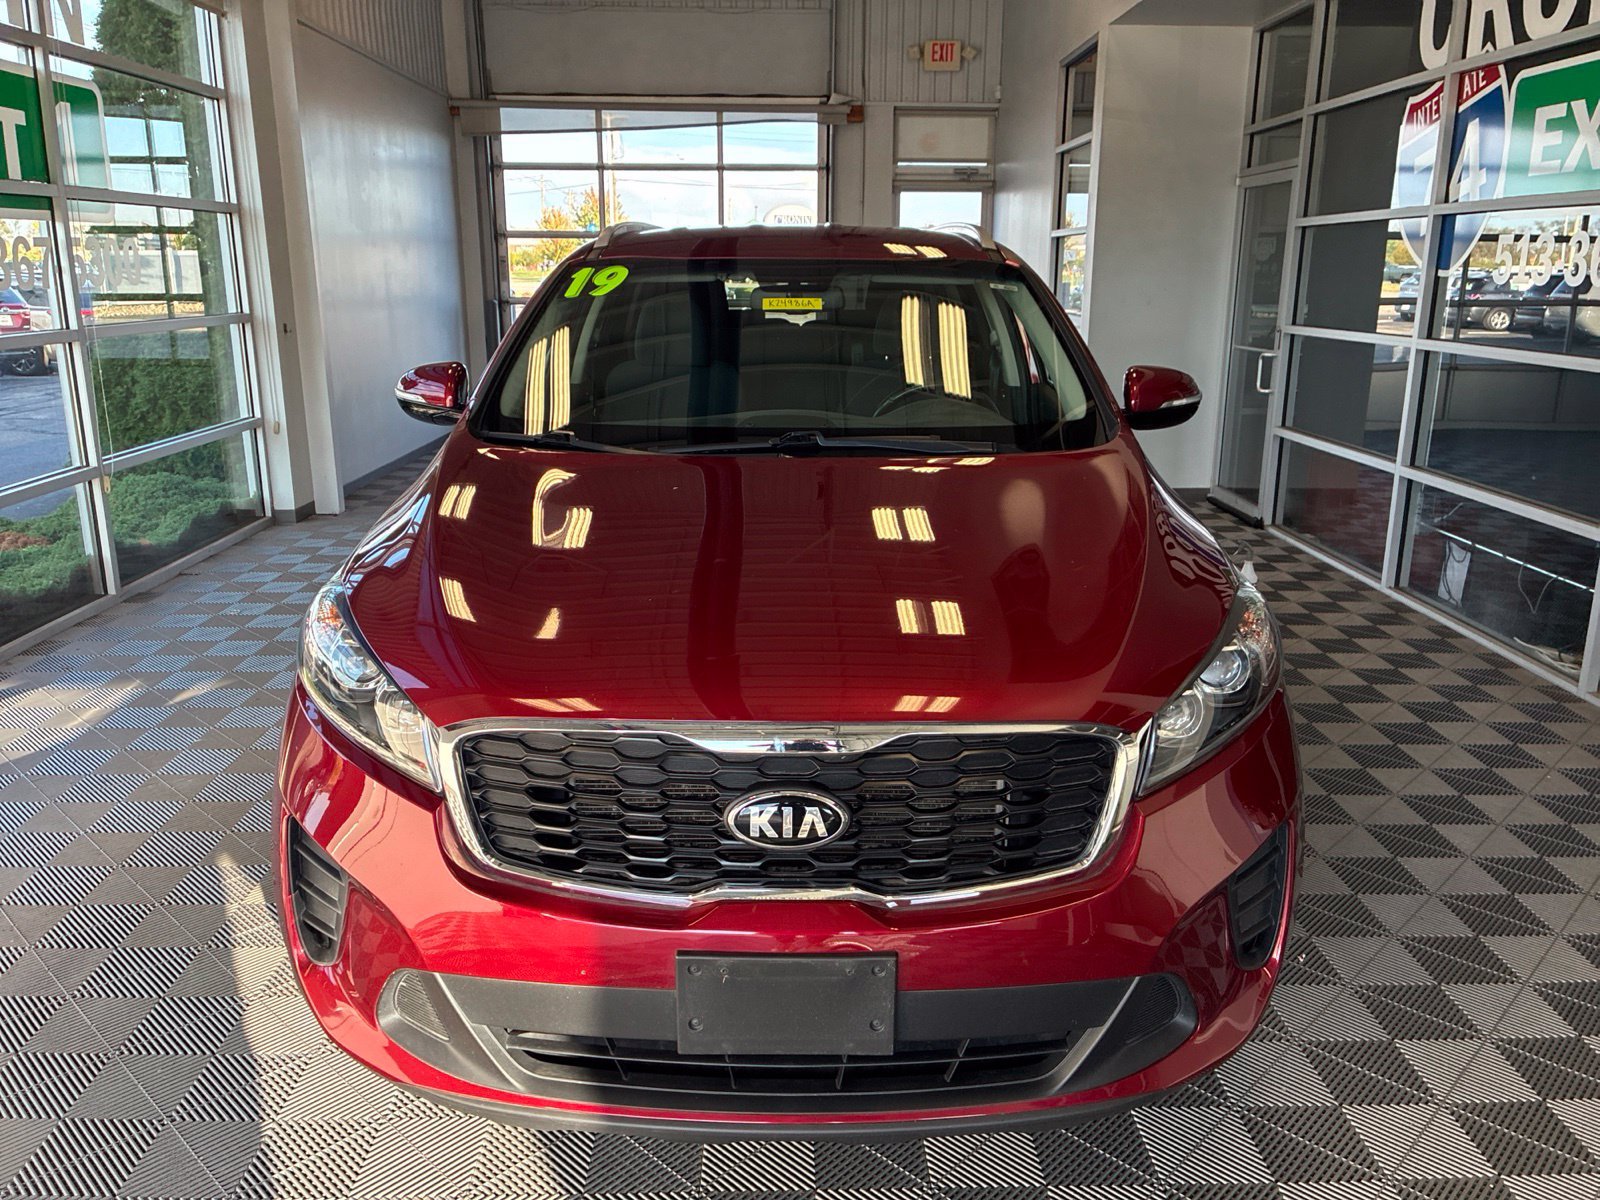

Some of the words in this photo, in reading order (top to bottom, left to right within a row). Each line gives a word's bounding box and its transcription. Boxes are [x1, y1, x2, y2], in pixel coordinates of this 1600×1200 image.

[931, 42, 956, 62] EXIT
[1413, 70, 1487, 131] INTEATE
[564, 264, 629, 298] 19
[749, 806, 828, 838] KIA
